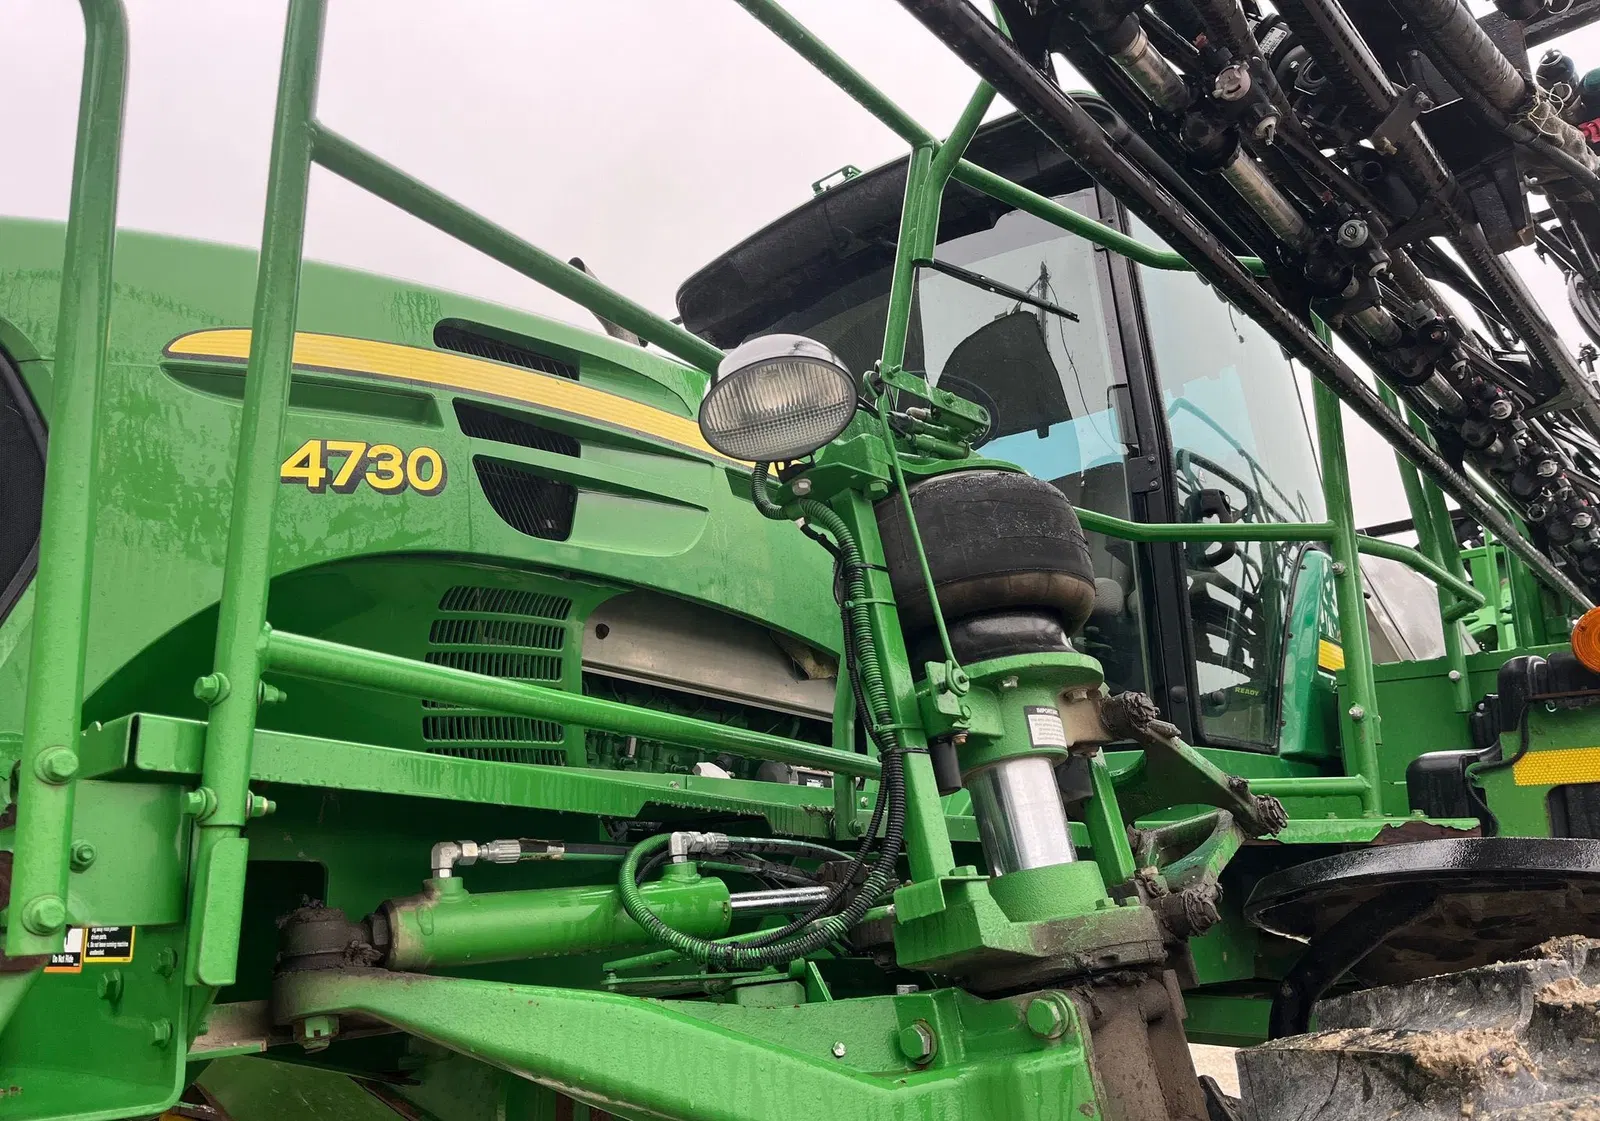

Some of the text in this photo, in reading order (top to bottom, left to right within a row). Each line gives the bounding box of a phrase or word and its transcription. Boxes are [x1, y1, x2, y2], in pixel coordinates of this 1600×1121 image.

[281, 439, 447, 496] 4730
[1235, 687, 1259, 696] READY
[52, 954, 58, 963] Do
[65, 954, 74, 963] Ride
